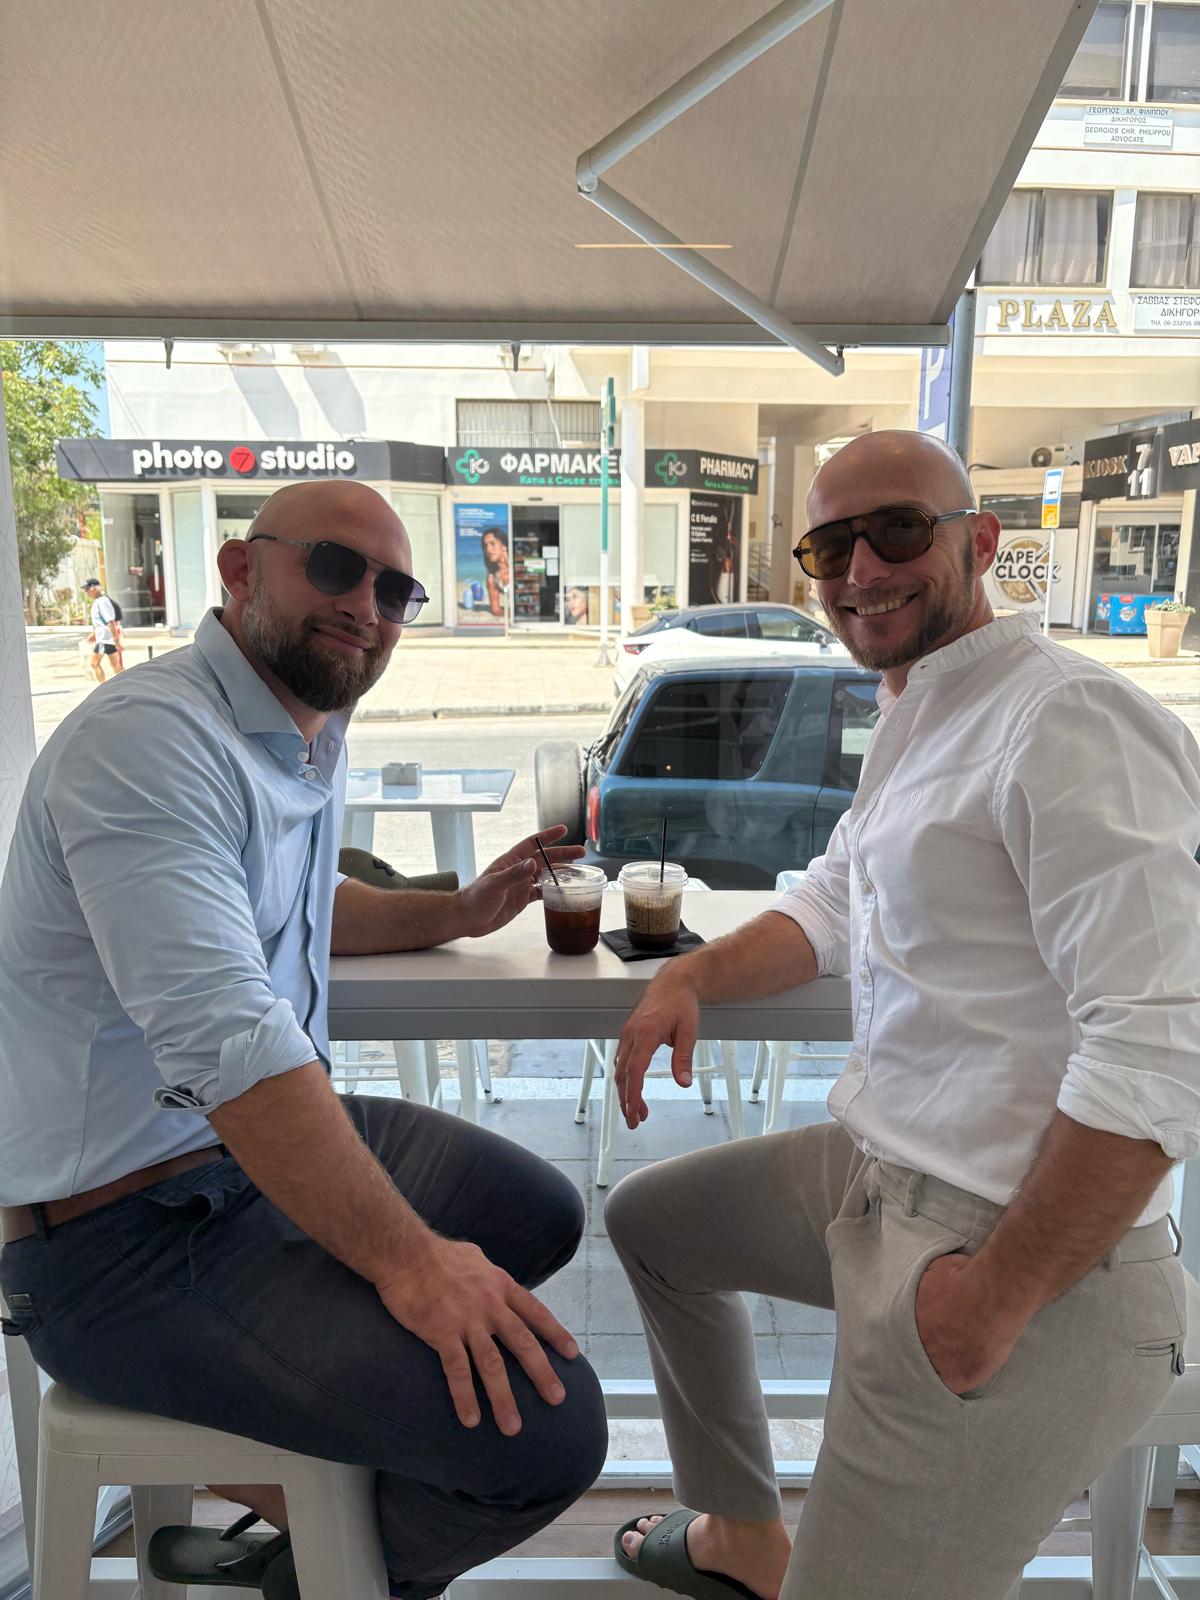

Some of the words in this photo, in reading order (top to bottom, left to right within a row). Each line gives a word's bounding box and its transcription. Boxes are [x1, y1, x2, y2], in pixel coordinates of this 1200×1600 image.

[1084, 126, 1119, 134] GEORGIOS
[1138, 128, 1171, 136] PHILIPPOU
[1110, 135, 1145, 143] ADVOCATE
[1137, 295, 1169, 305] ΣΑΒΒΑΣ
[997, 299, 1118, 328] PLAZA
[1160, 307, 1200, 317] ΔΙΚΗΓΟΡ
[132, 441, 223, 475] photo
[260, 443, 355, 471] studio
[500, 452, 621, 475] ΦΑΡΜΑΚΕ
[700, 456, 755, 480] PHARMACY
[1085, 454, 1128, 479] KIOSK
[997, 551, 1034, 564] VAPE
[995, 564, 1061, 580] CLOCK
